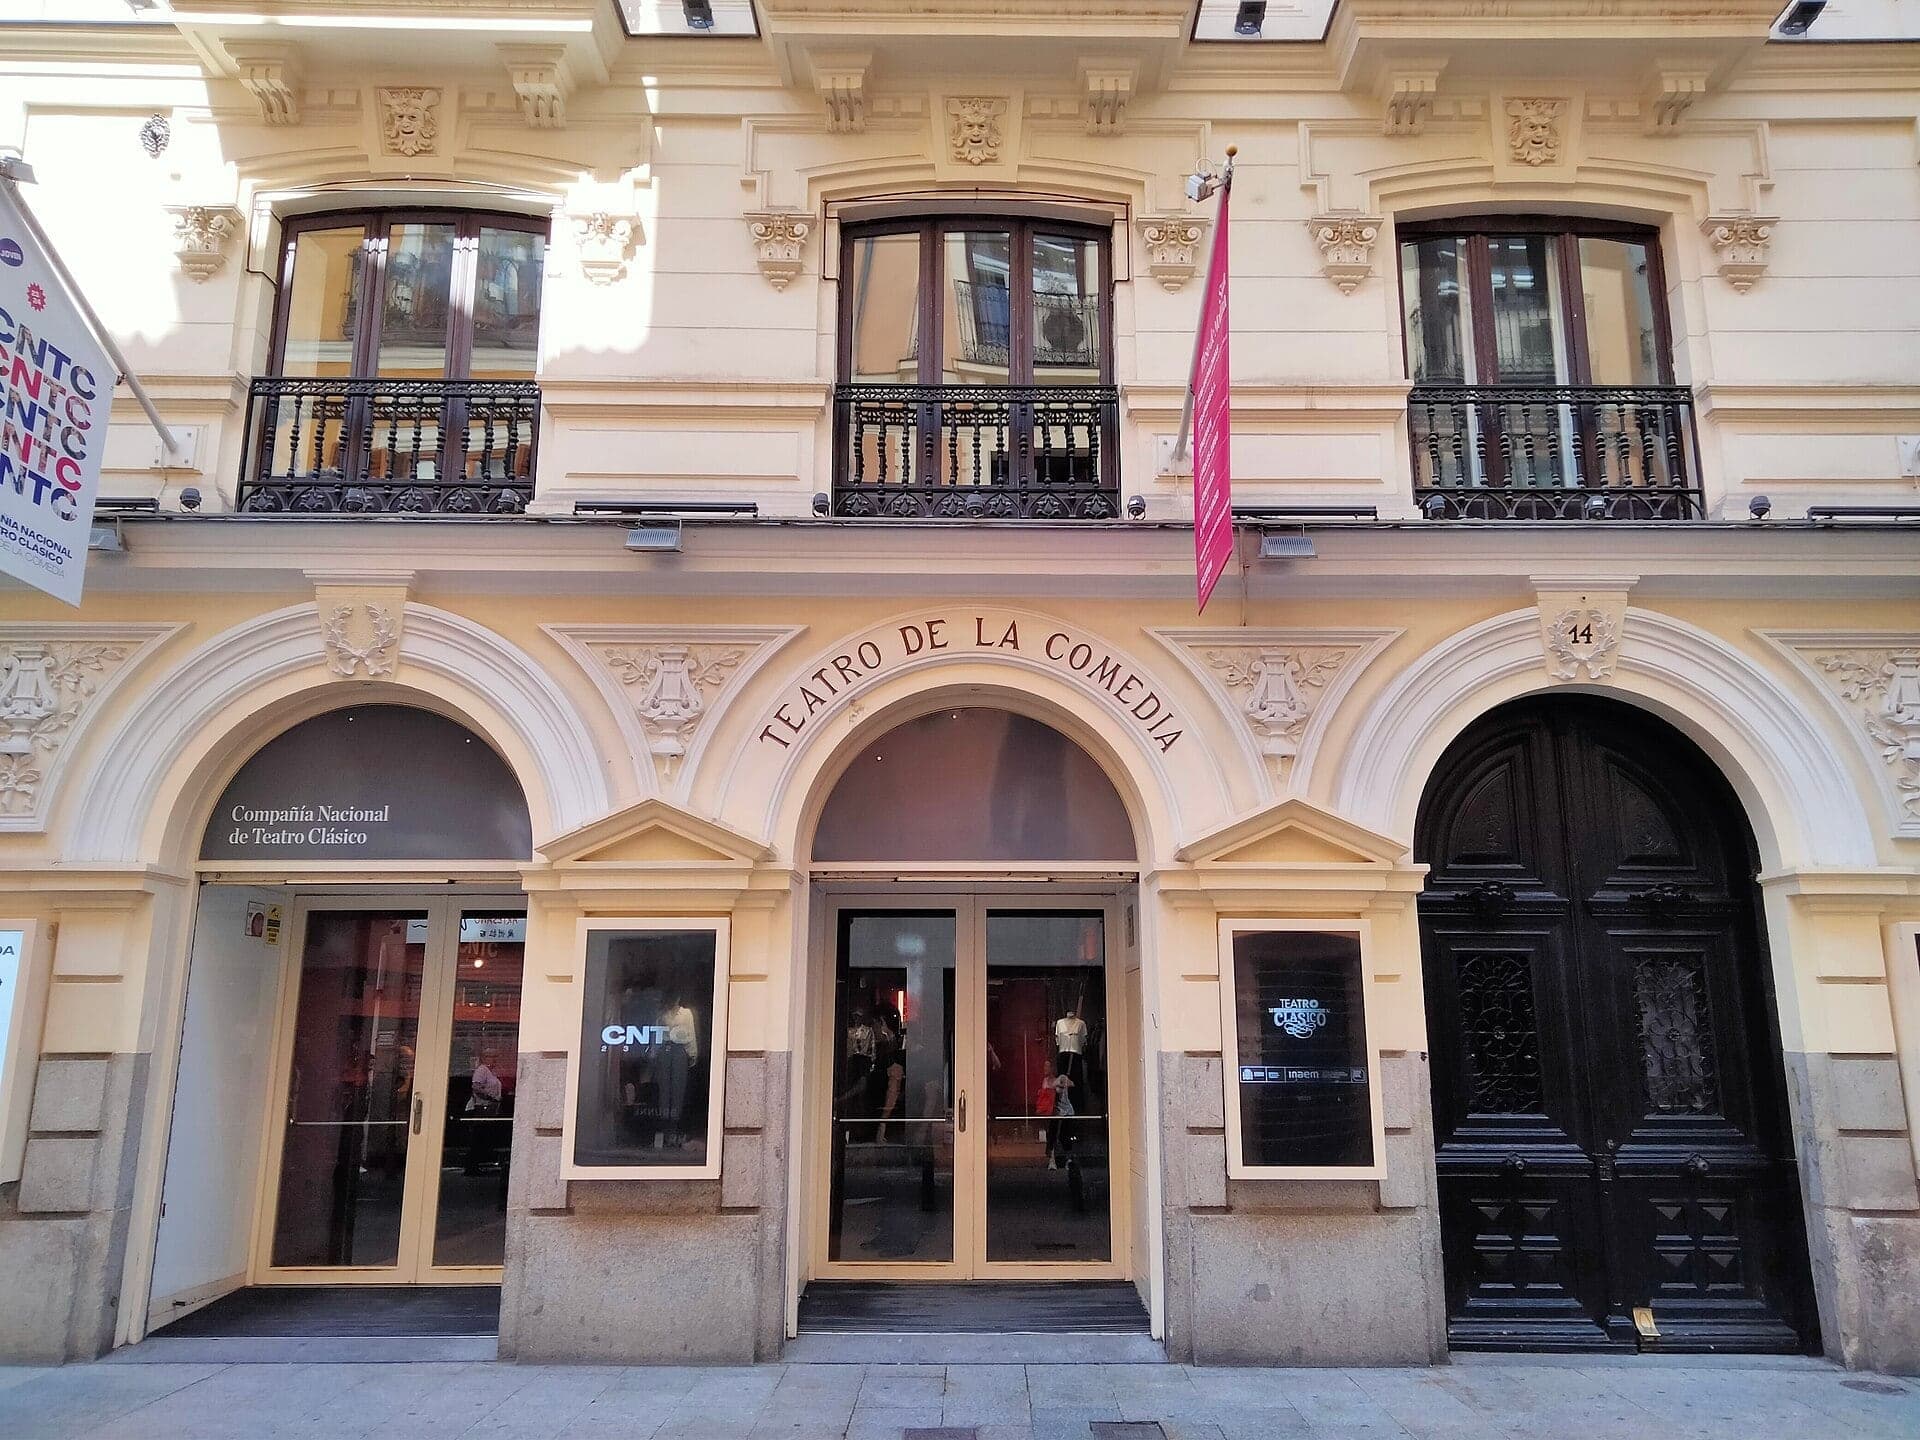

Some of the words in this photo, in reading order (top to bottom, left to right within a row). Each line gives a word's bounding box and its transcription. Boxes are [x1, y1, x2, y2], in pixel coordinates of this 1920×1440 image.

[0, 382, 86, 460] NTC
[0, 420, 81, 491] NTC
[21, 525, 72, 559] NACIONAL
[1568, 623, 1593, 644] 14
[759, 641, 882, 749] TEATRO
[900, 619, 948, 656] DE
[975, 617, 1020, 650] LA
[1045, 633, 1184, 754] COMEDIA
[231, 805, 314, 825] Compañía
[317, 805, 389, 822] Nacional
[229, 828, 248, 844] de
[252, 828, 304, 844] Teatro
[308, 828, 367, 844] Clásico
[1279, 998, 1319, 1009] TEATRO
